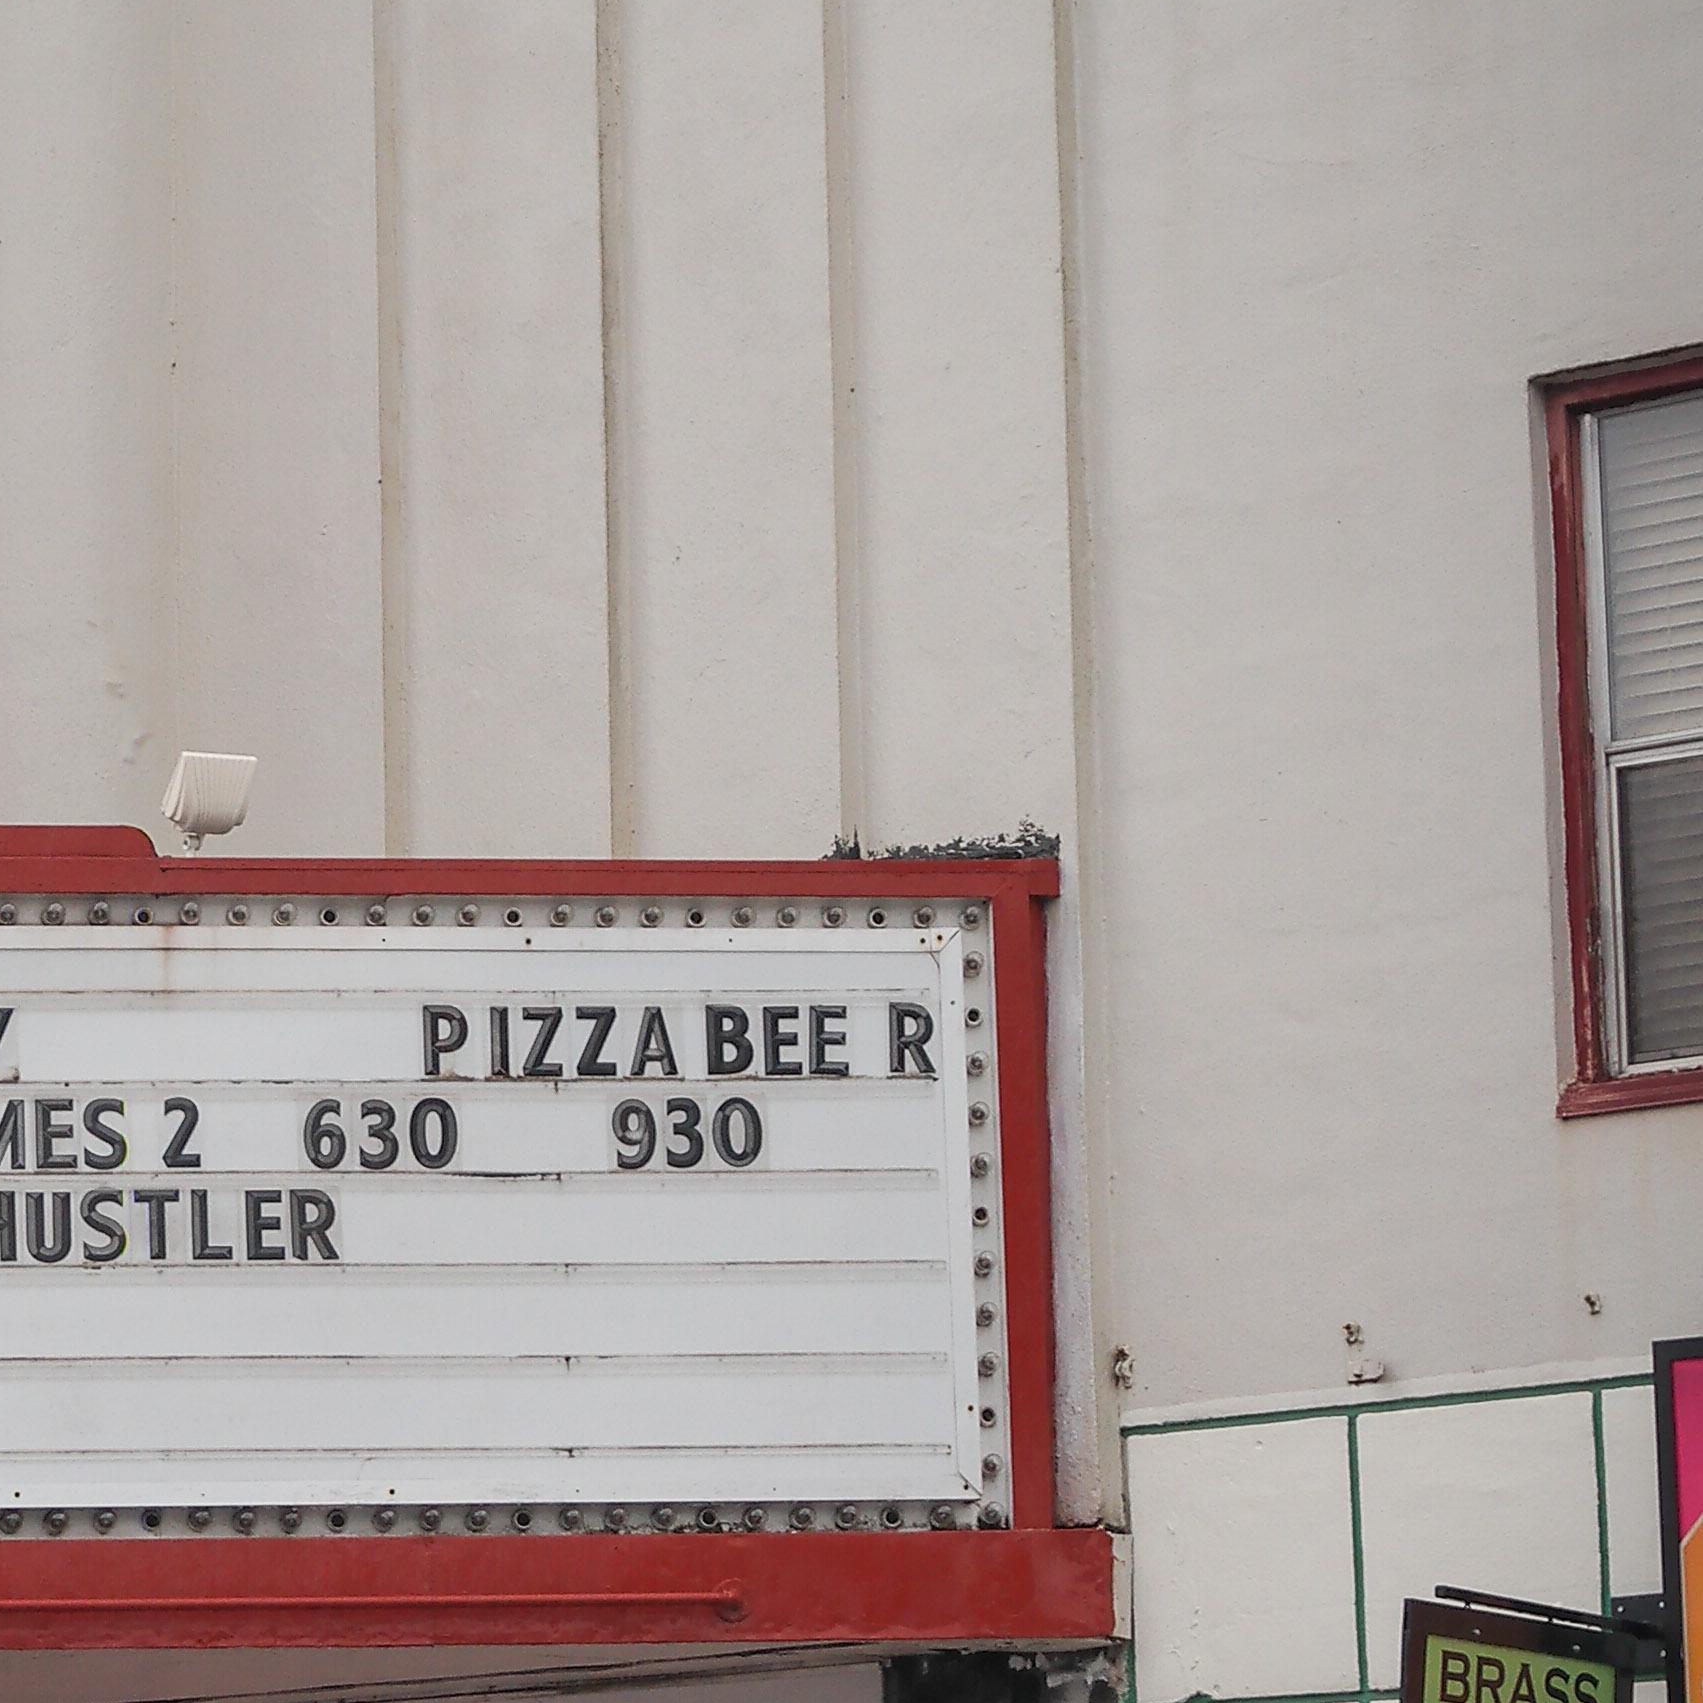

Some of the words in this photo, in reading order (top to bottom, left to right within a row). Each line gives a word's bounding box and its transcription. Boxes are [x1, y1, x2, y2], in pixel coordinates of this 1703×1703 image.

[162, 1097, 202, 1169] 2
[303, 1097, 458, 1171] 630
[611, 1096, 763, 1171] 930
